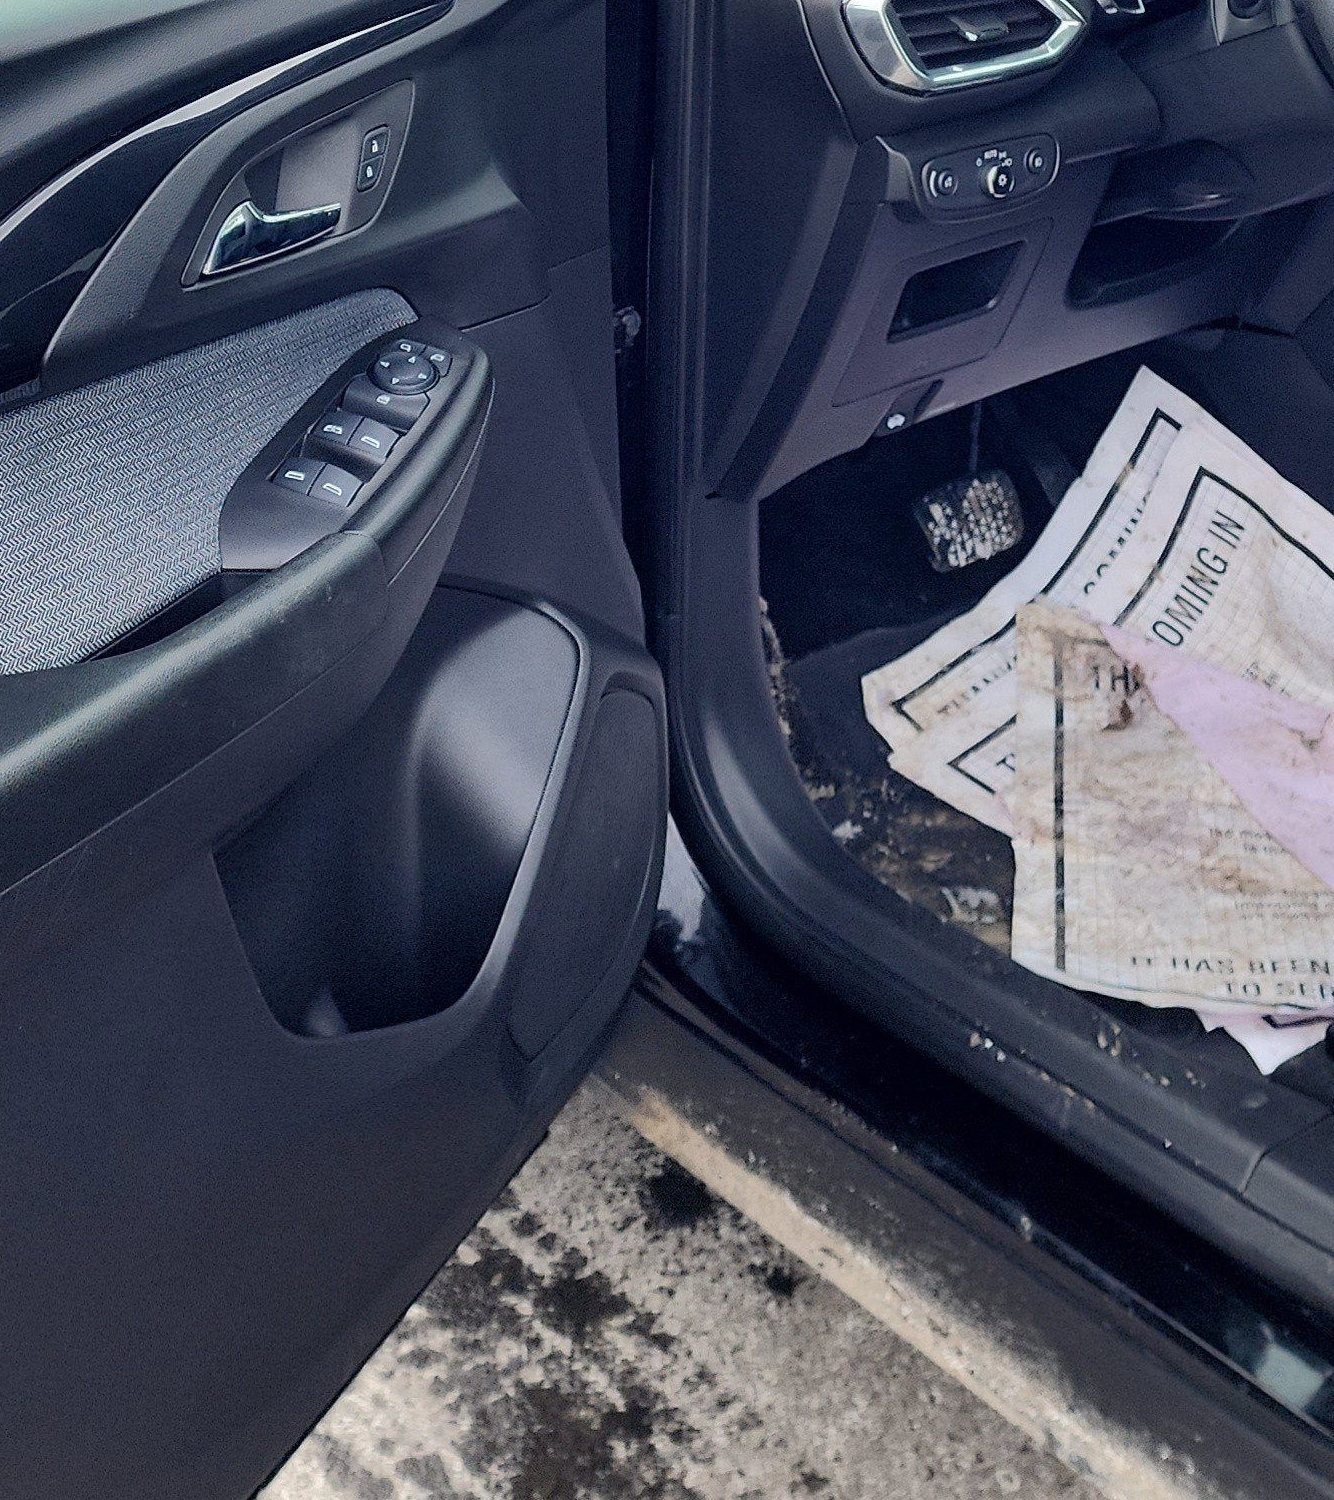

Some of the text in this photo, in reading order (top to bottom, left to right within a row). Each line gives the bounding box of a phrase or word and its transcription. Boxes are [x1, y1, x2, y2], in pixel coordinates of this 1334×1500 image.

[1149, 509, 1245, 647] OMING IN
[1131, 955, 1154, 968] IT
[1171, 956, 1234, 975] HAS
[1249, 958, 1330, 977] BEEN
[1224, 981, 1262, 998] TO
